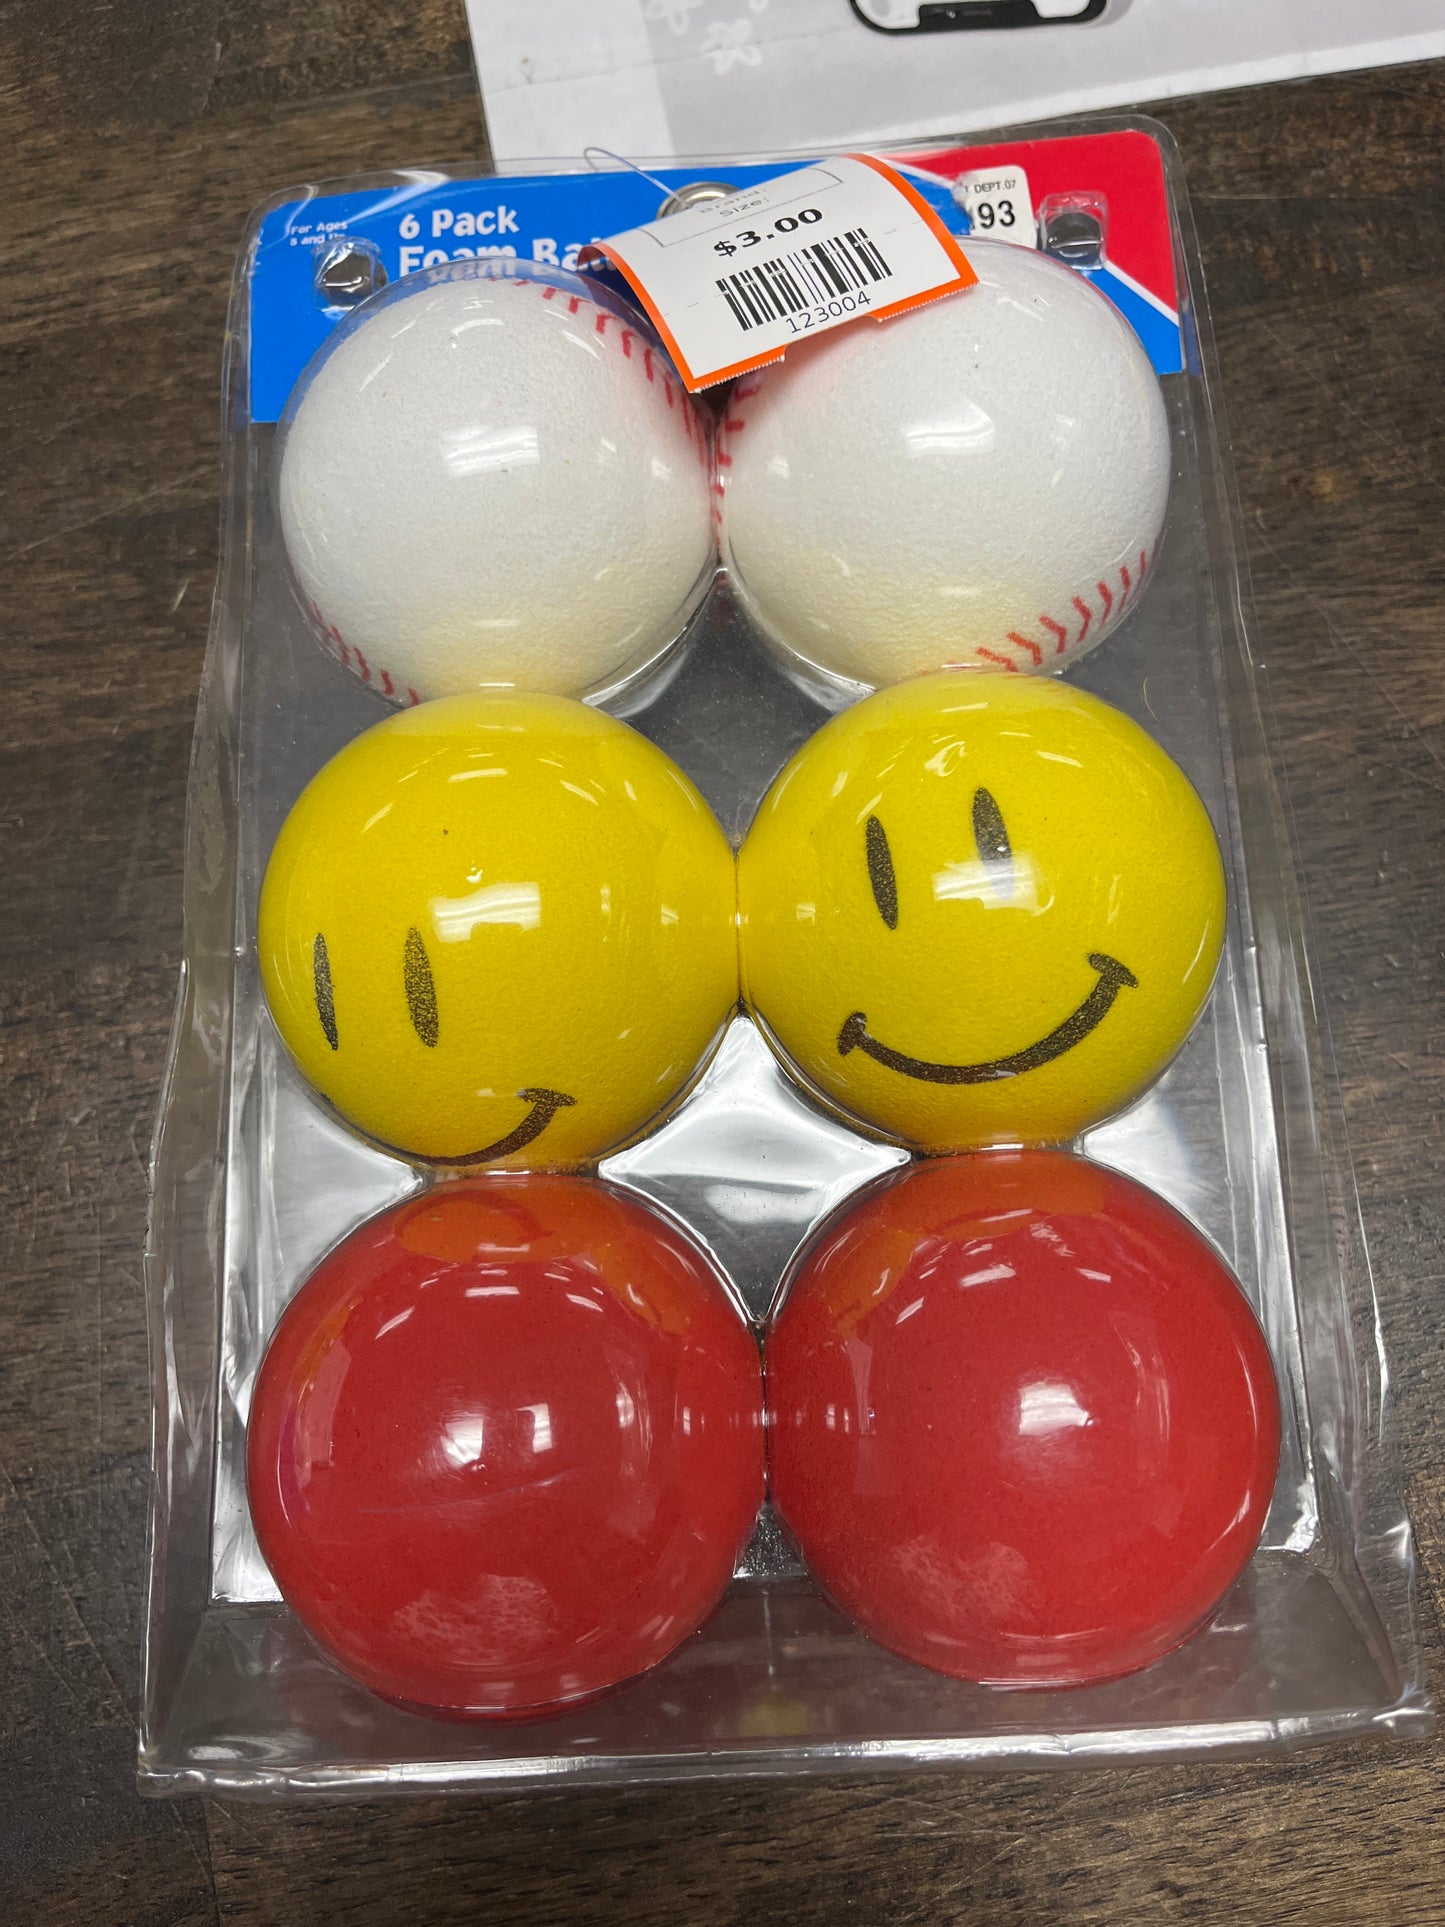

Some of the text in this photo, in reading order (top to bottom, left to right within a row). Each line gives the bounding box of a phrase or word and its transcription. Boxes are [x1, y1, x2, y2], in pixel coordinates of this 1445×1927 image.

[973, 179, 1017, 194] DEPT.07
[290, 221, 348, 235] For Ages
[398, 205, 520, 240] 6 Pack
[971, 200, 1016, 230] 93
[301, 234, 326, 246] and
[713, 208, 823, 257] $3.00
[785, 290, 872, 334] 123004
